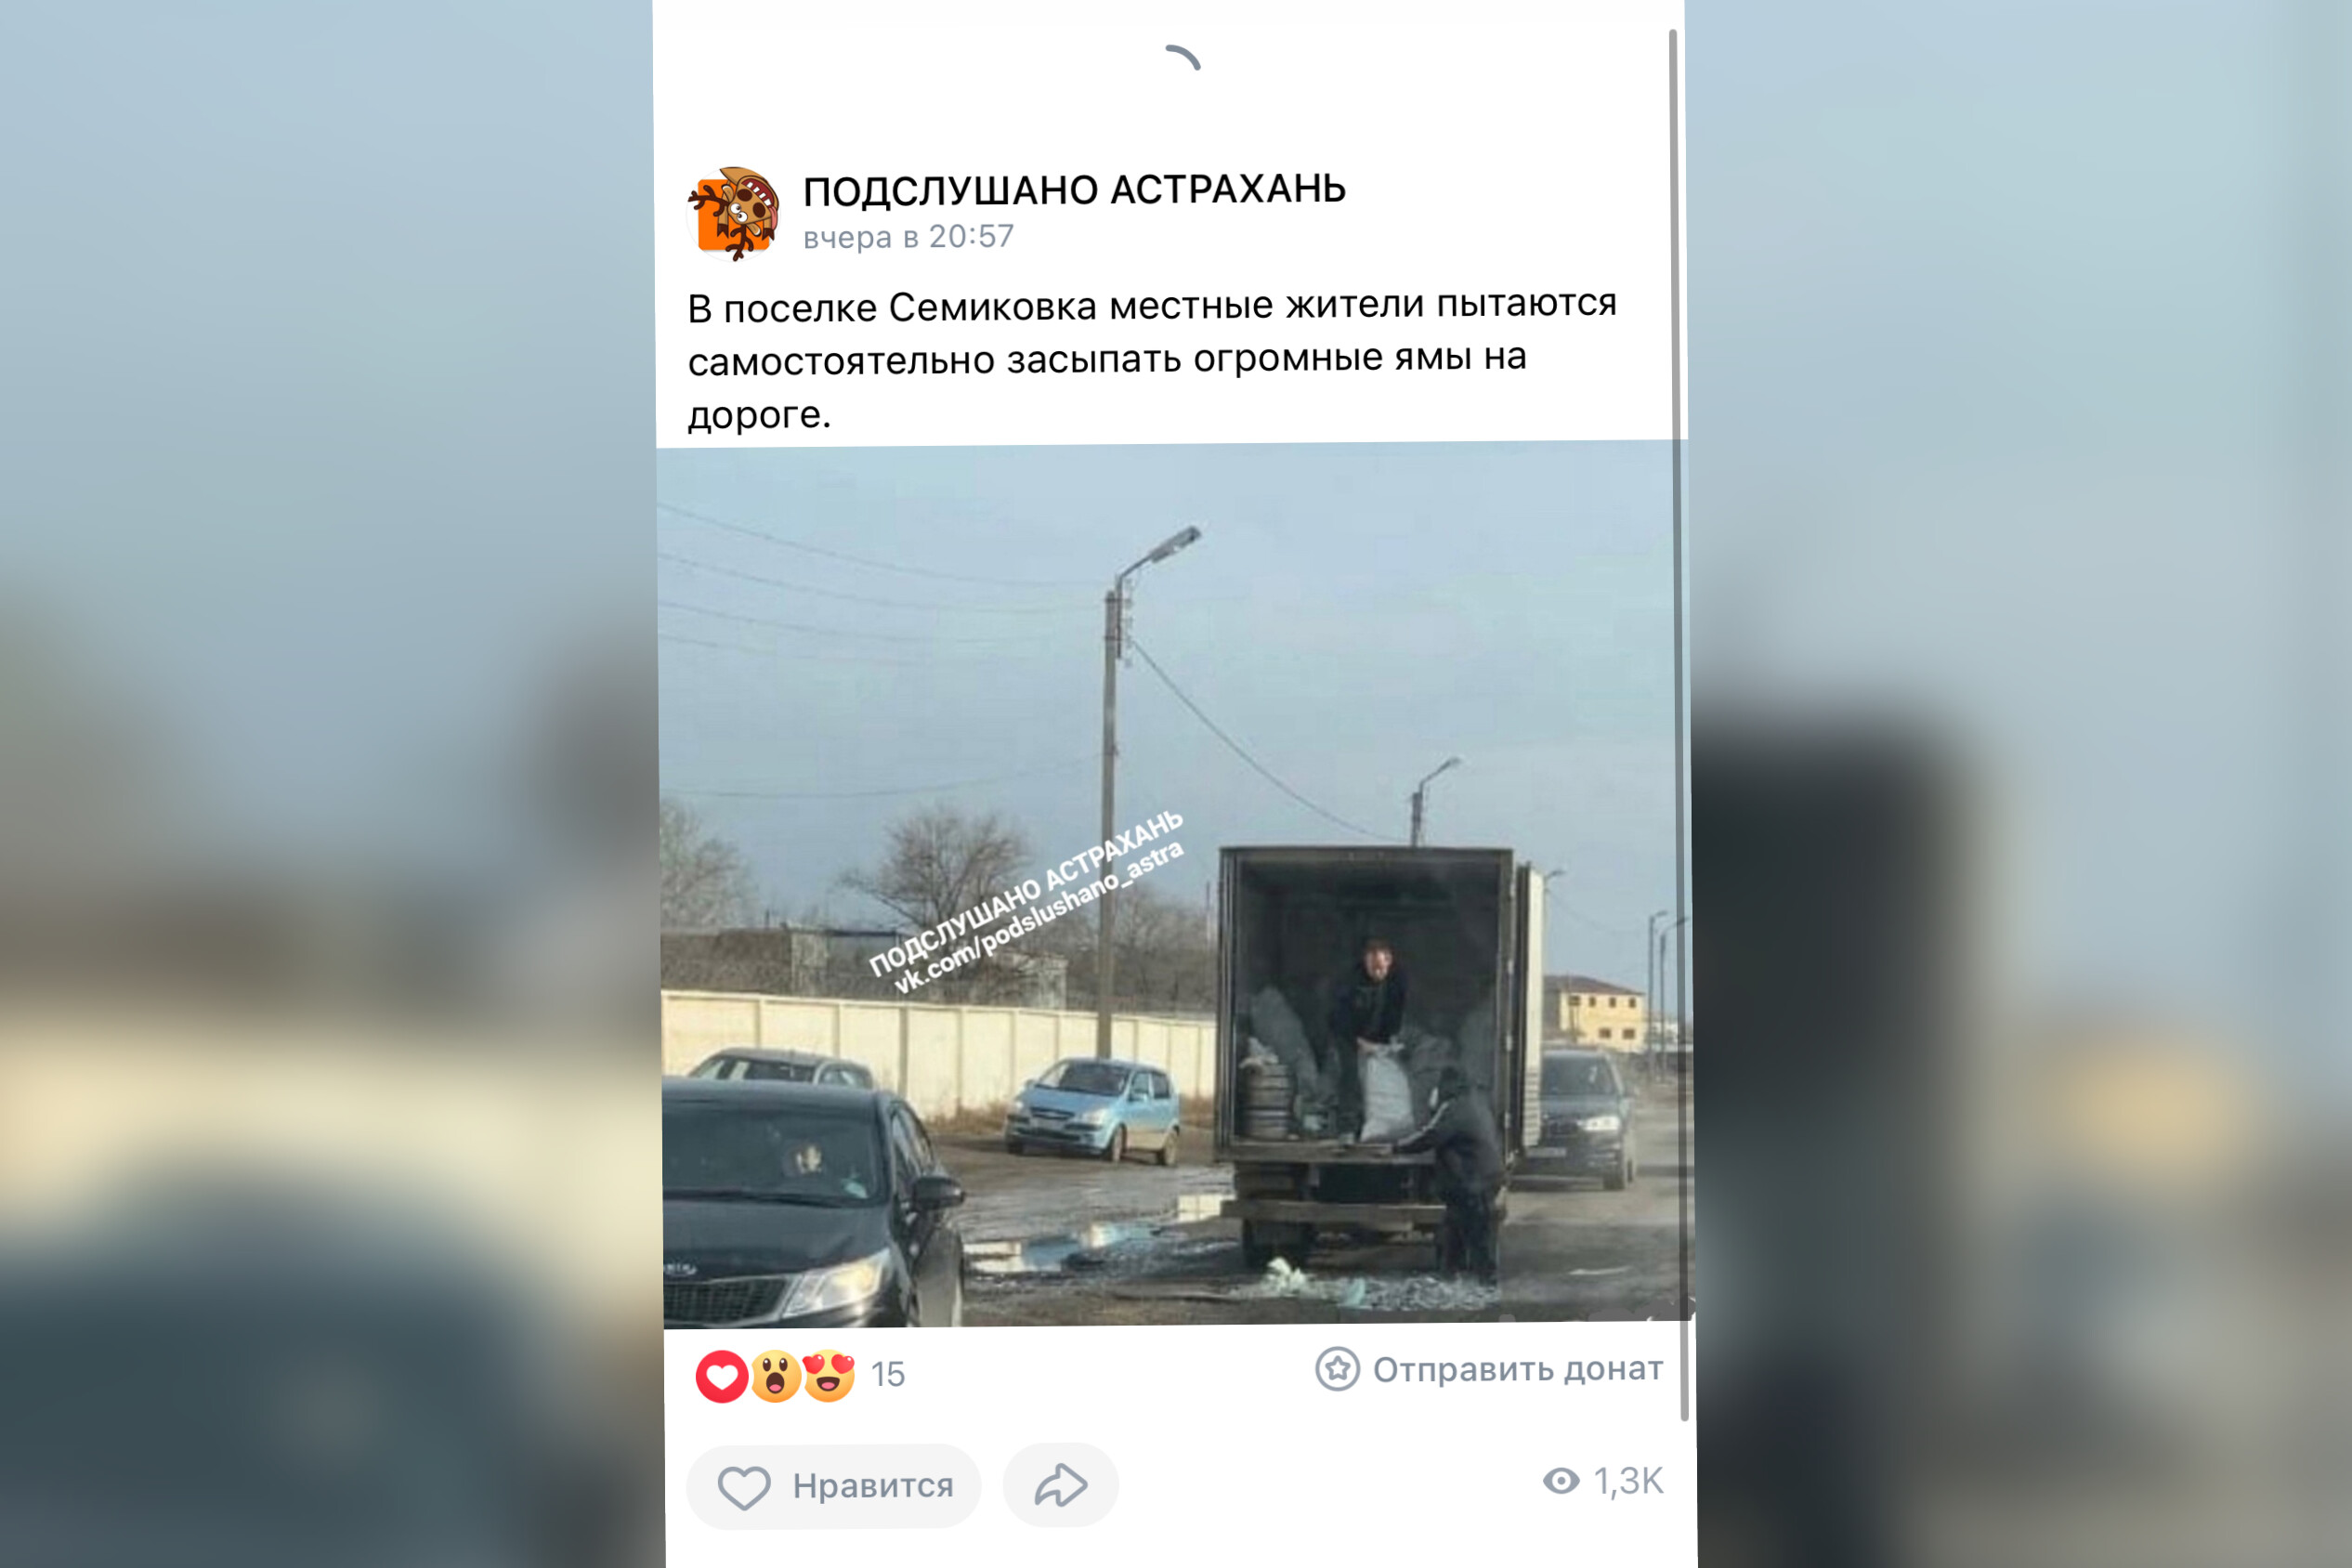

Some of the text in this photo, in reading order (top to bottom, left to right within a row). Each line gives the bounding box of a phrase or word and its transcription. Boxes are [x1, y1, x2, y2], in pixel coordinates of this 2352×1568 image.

[805, 173, 1346, 212] ПОДСЛУШАНО АСТРАХАНЬ
[805, 224, 1013, 254] вчера в 20:57
[690, 292, 1615, 323] В поселке Семиковка местные жители пытаются
[689, 346, 1525, 378] самостоятельно засыпать огромные ямы на
[687, 406, 830, 436] дороге.
[872, 1361, 905, 1387] 15
[1374, 1357, 1664, 1388] Отправить донат
[795, 1473, 952, 1504] Нравится
